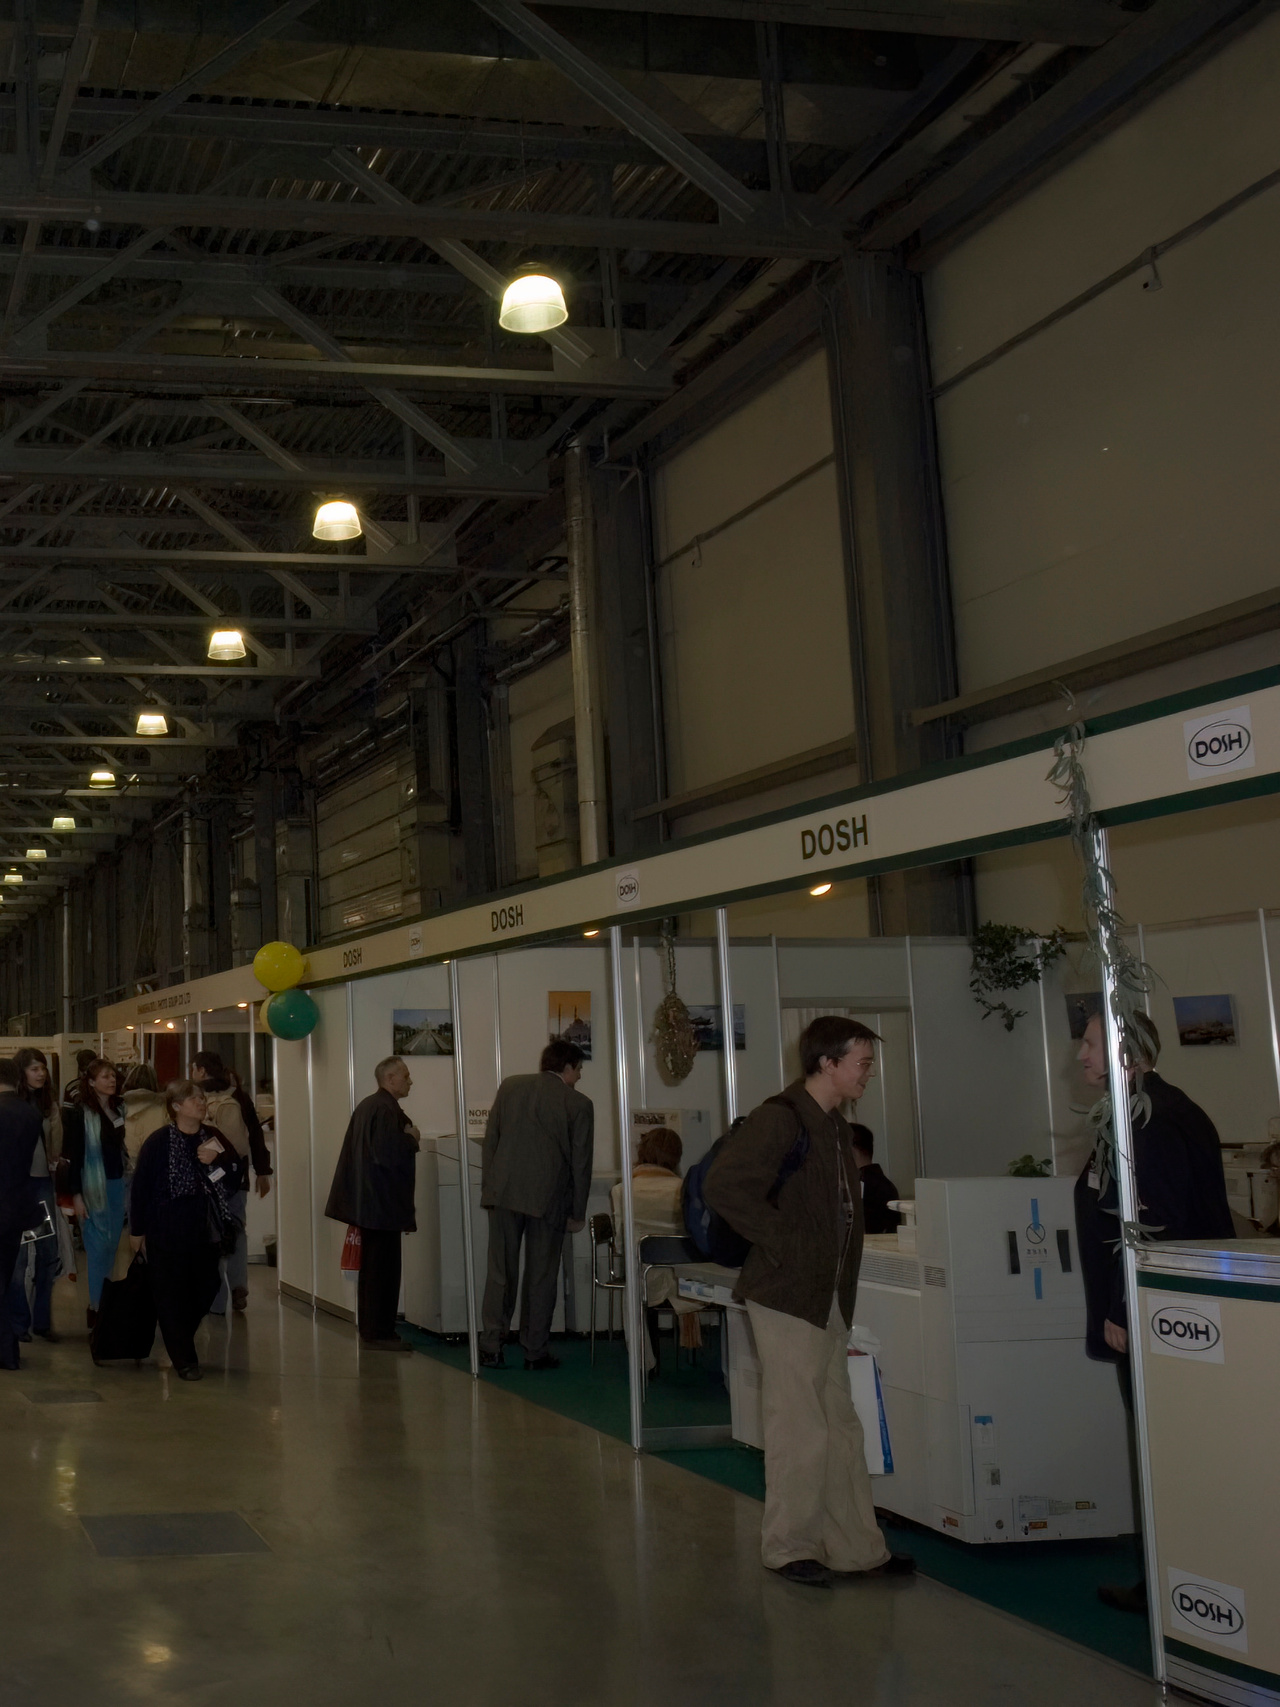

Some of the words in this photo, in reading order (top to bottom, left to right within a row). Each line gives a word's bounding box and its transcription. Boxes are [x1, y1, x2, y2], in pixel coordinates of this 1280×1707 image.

[1195, 731, 1243, 760] DOSH
[801, 813, 869, 860] DOSH
[619, 882, 637, 897] DOSH
[490, 903, 525, 933] DOSH
[343, 947, 362, 968] DOSH
[1158, 1317, 1210, 1343] DOSH
[1178, 1594, 1233, 1627] DOSH
